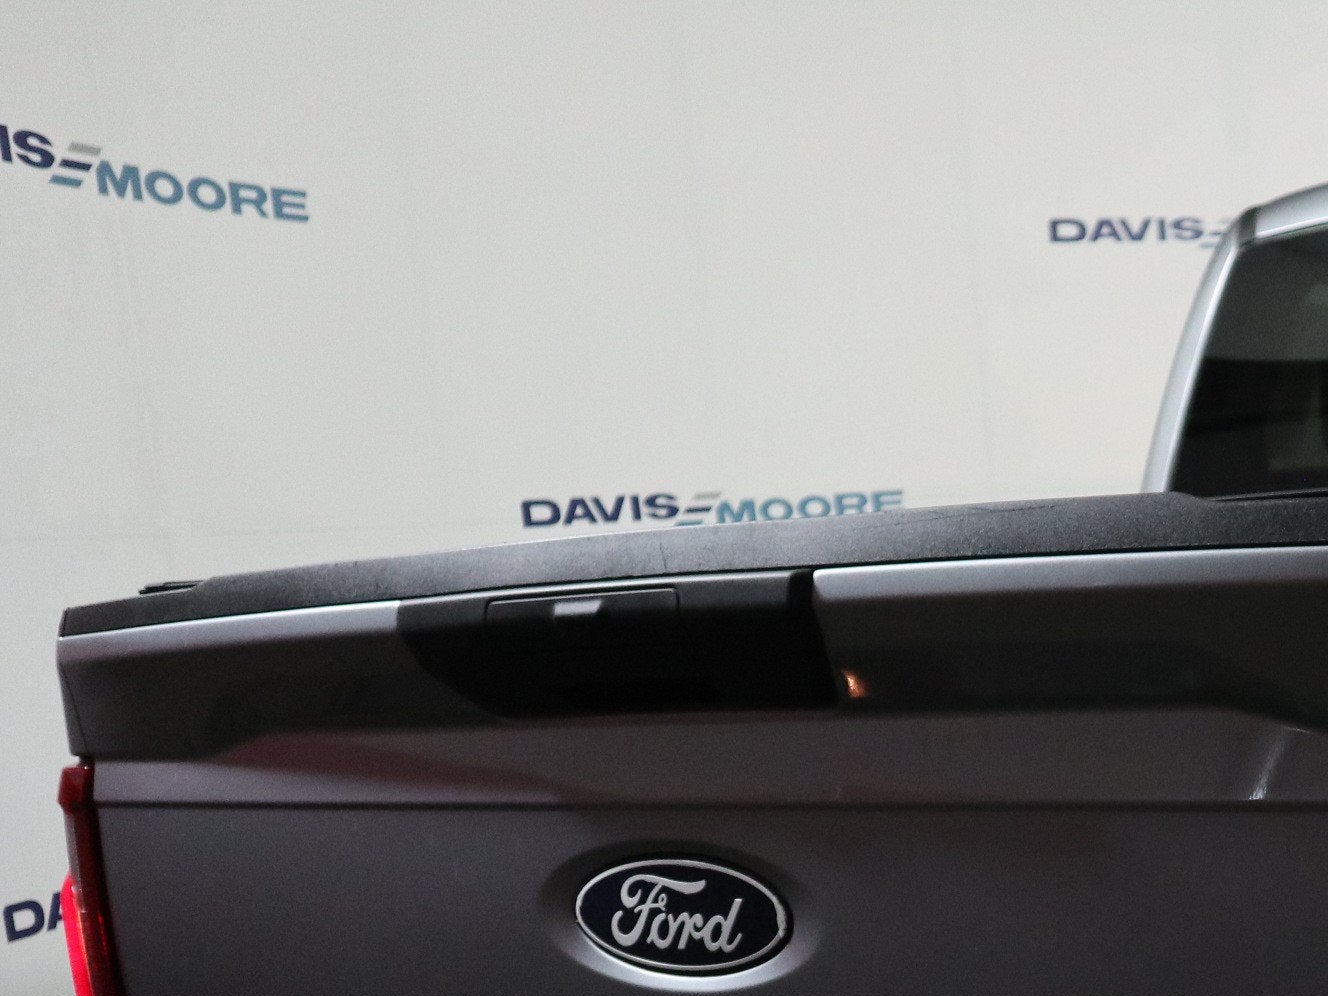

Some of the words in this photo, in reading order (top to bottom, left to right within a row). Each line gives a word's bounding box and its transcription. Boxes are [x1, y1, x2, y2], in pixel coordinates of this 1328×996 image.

[96, 160, 309, 223] MOORE
[1049, 216, 1203, 242] DAVIS
[521, 493, 680, 528] DAVIS
[611, 874, 743, 953] Ford
